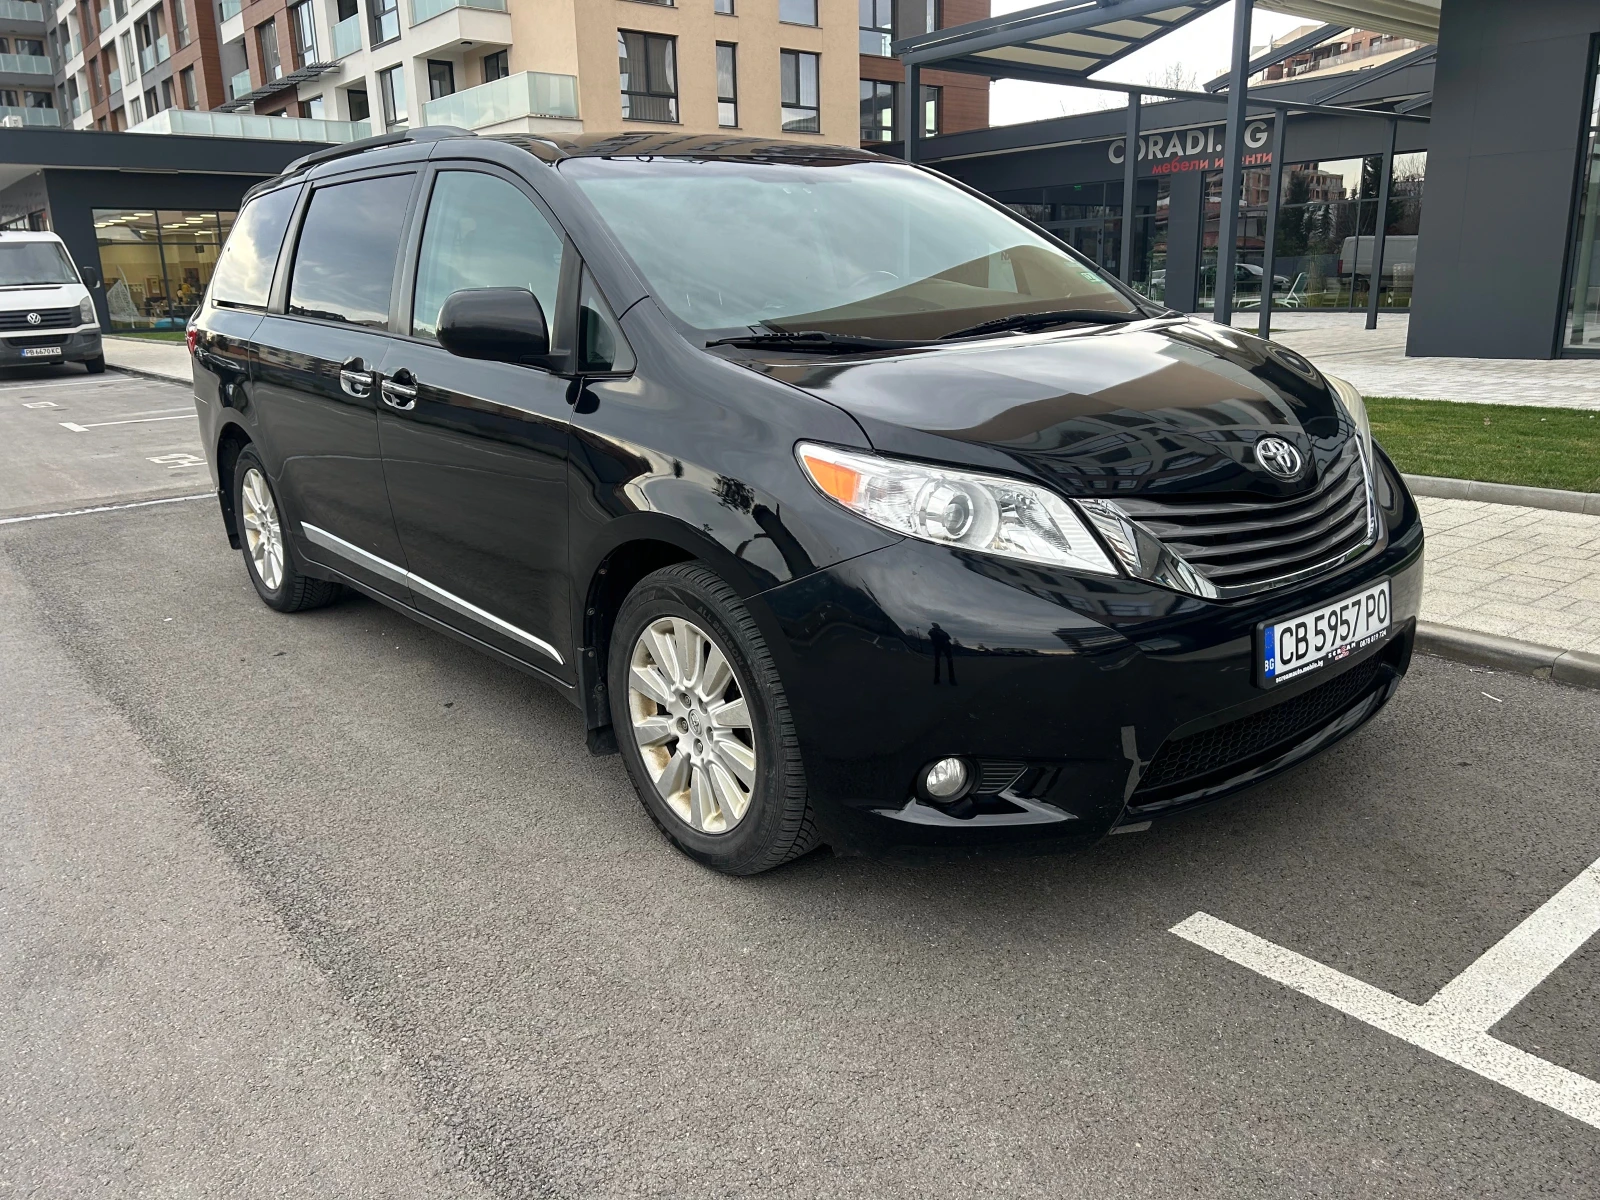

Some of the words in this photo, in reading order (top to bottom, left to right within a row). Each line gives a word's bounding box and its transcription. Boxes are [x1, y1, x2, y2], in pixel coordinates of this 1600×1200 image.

[1108, 121, 1268, 164] CRADI.G
[1152, 155, 1209, 175] мебели
[1215, 151, 1273, 169] инти
[696, 606, 712, 623] ALL
[712, 621, 745, 666] SEASON
[1279, 621, 1309, 666] CB
[1314, 599, 1362, 652] 5957
[1365, 588, 1387, 631] PO
[1264, 658, 1275, 672] BG
